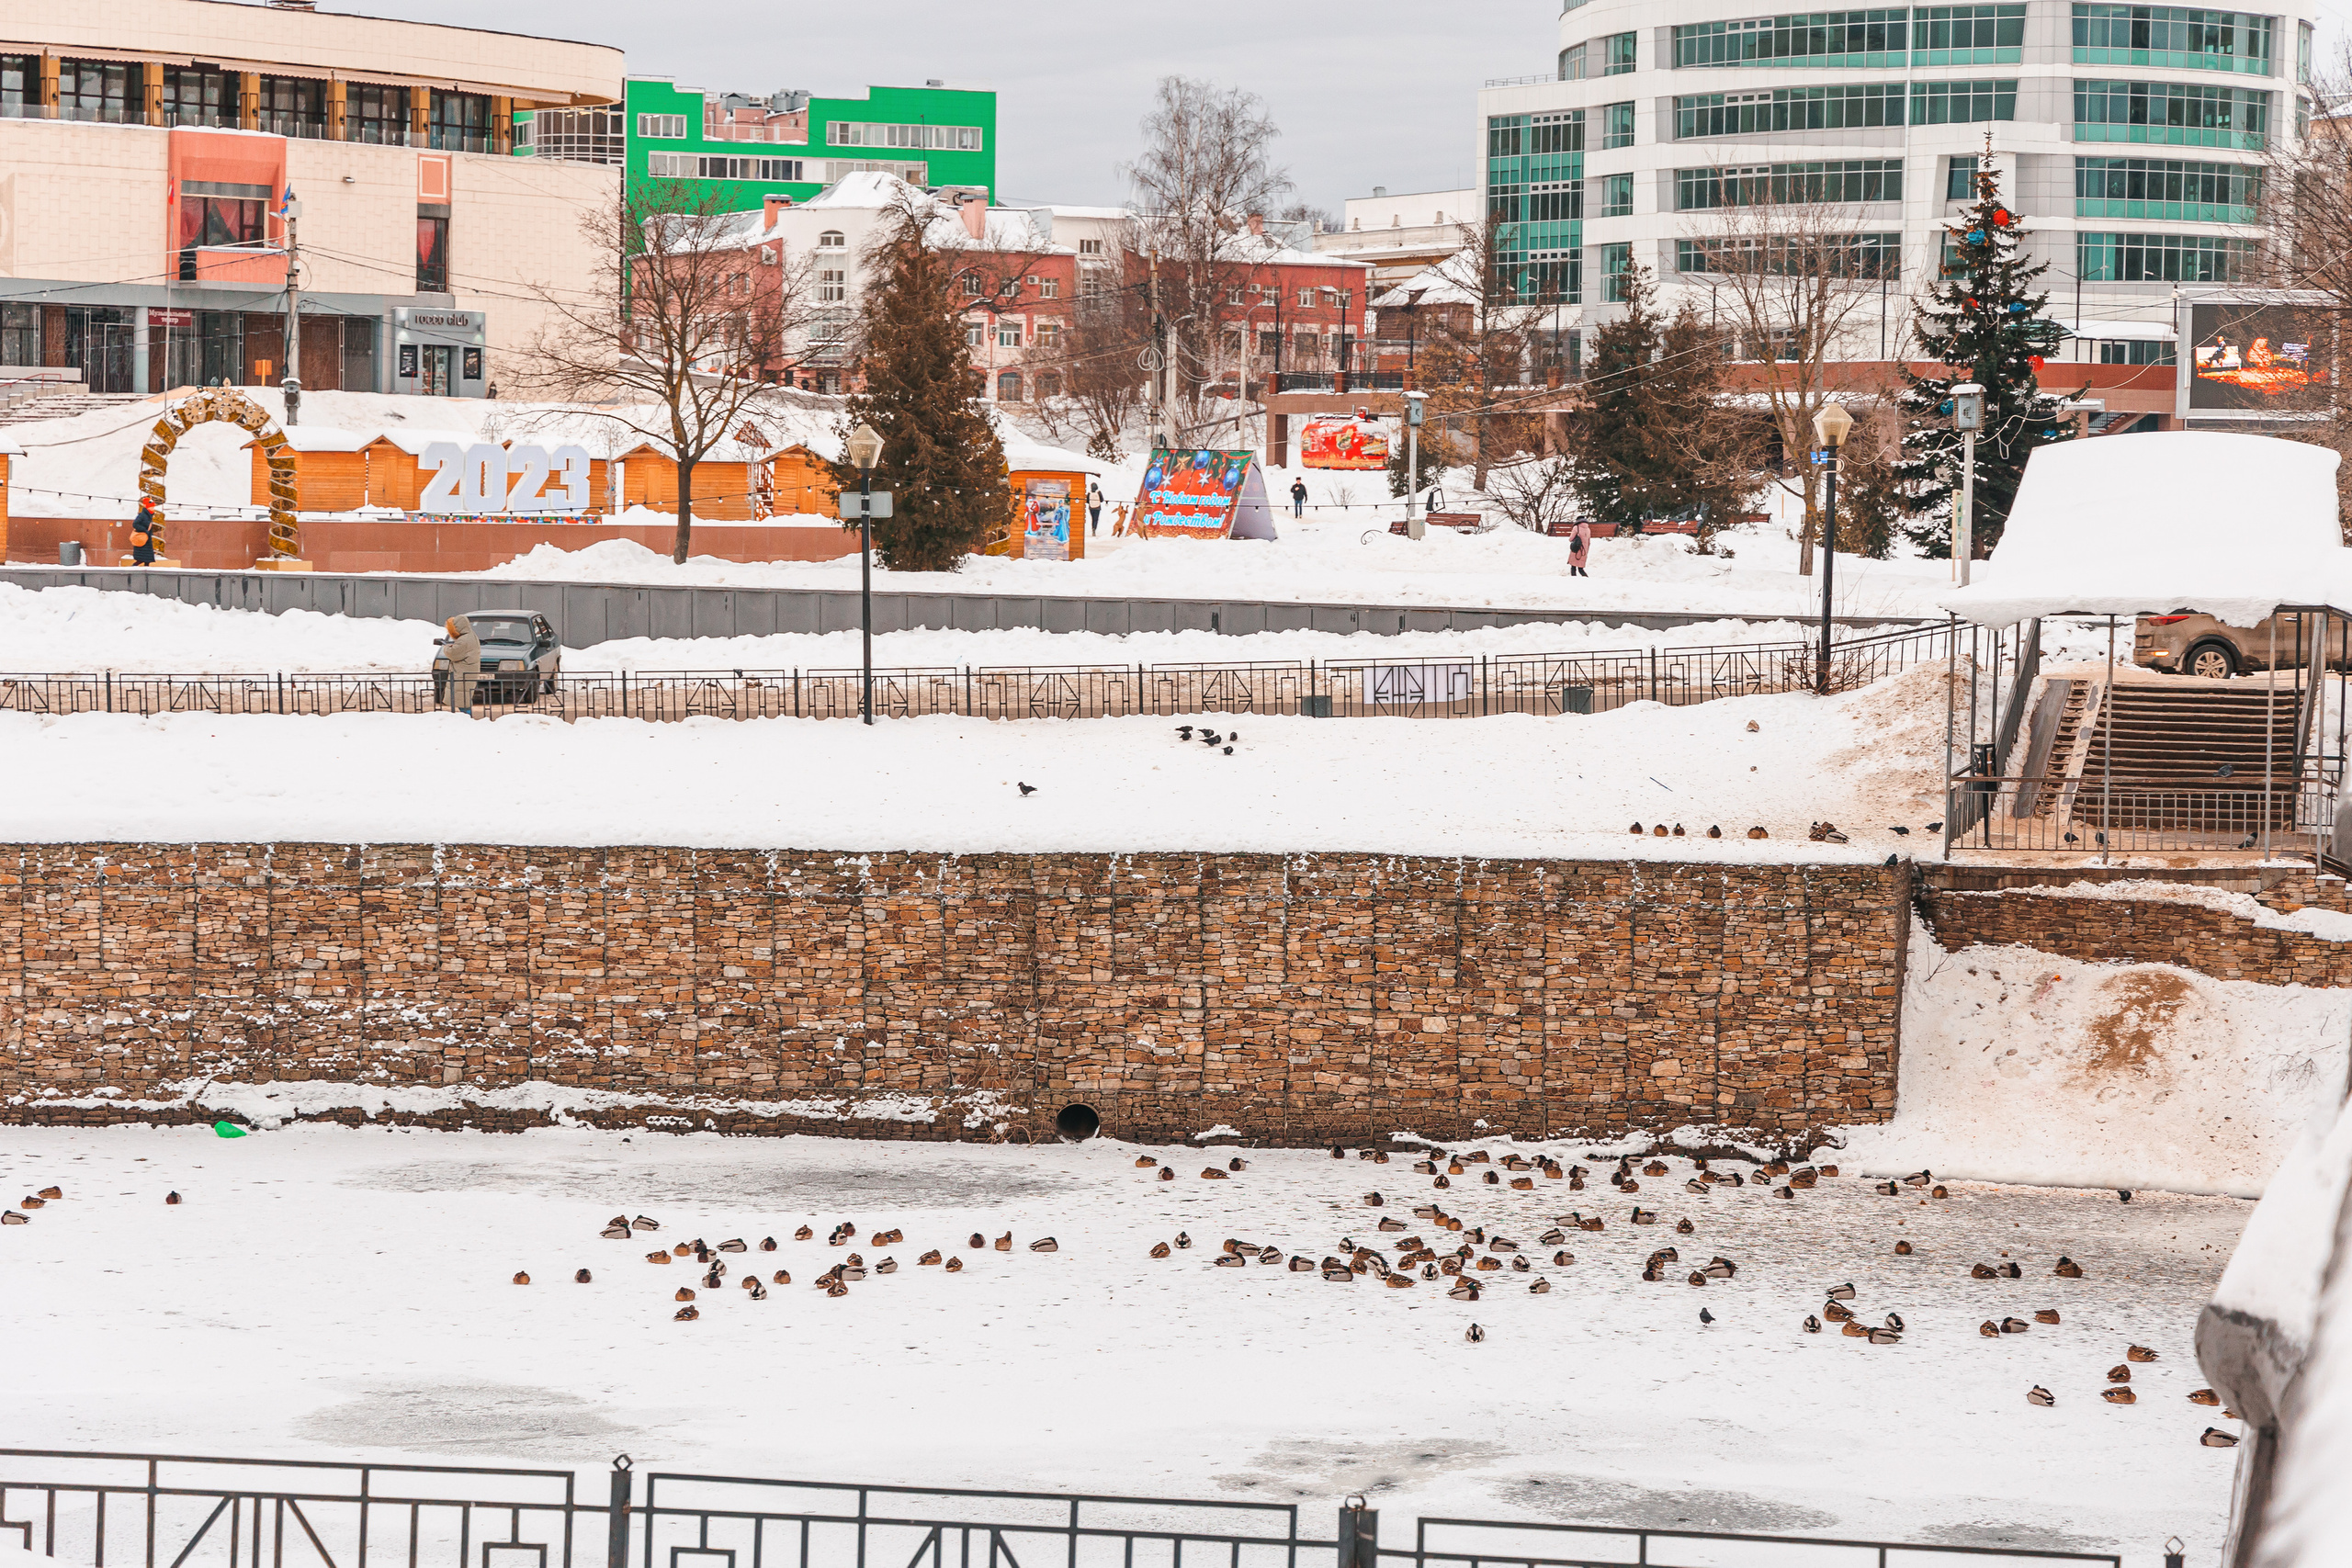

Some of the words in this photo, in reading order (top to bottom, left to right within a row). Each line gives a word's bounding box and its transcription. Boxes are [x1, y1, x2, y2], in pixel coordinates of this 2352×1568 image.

[415, 314, 444, 325] rocco
[447, 313, 469, 326] club
[418, 442, 590, 513] 2023
[1149, 490, 1161, 504] С
[1162, 491, 1198, 505] Новым
[1199, 492, 1231, 507] годом
[1143, 514, 1151, 525] и
[1152, 511, 1227, 528] Рождеством!
